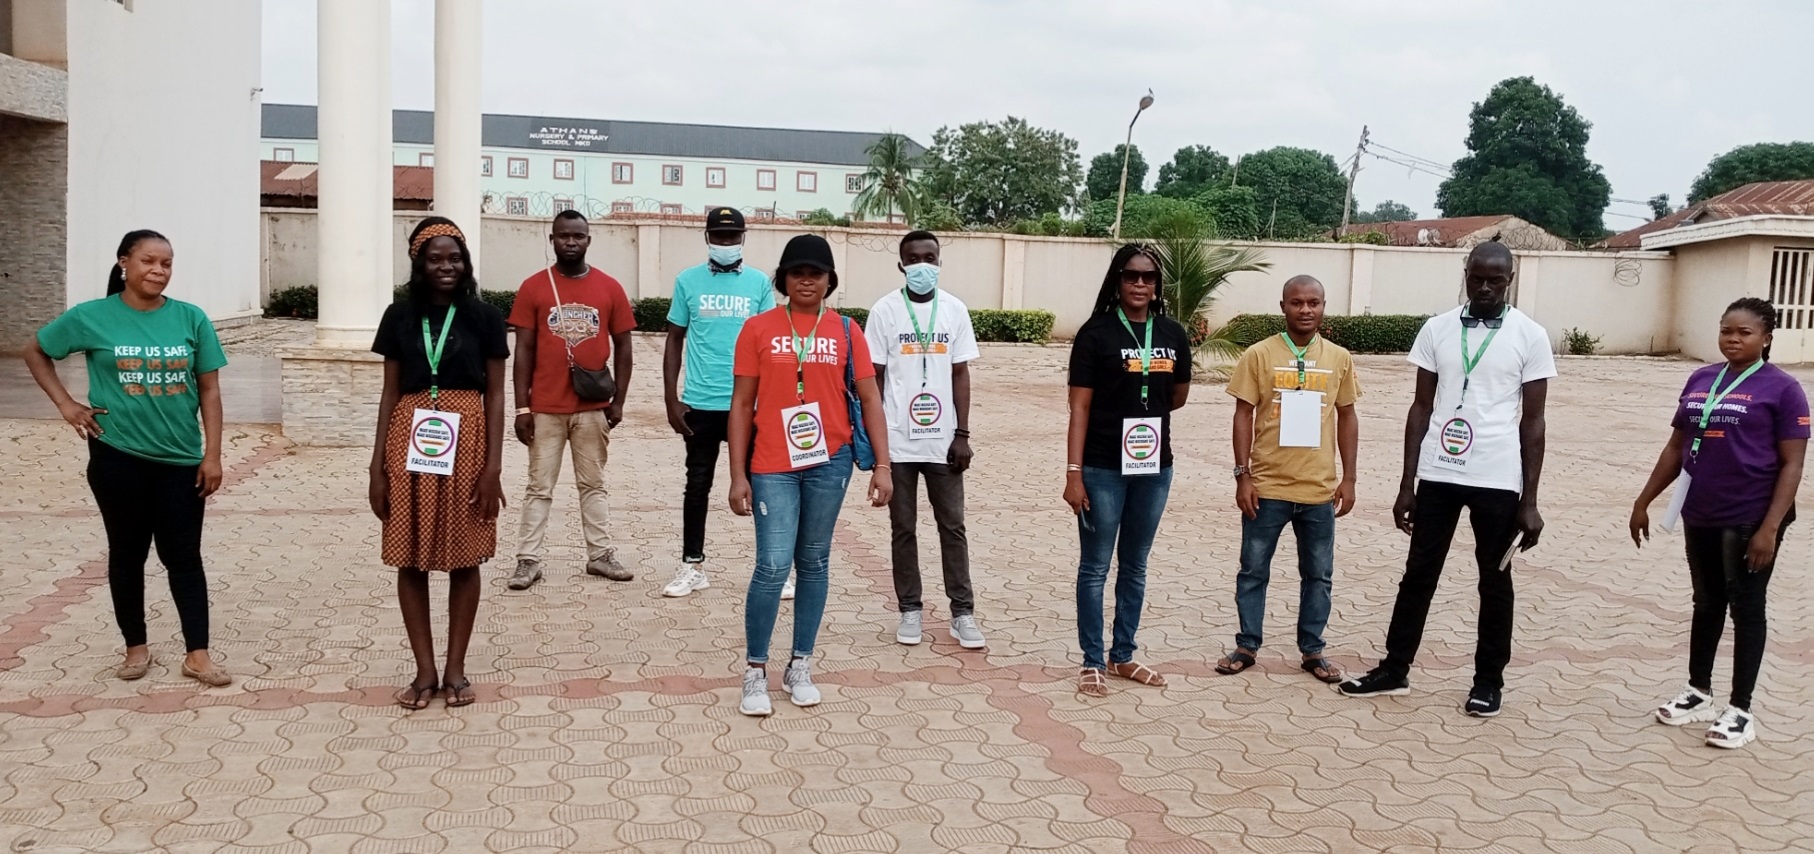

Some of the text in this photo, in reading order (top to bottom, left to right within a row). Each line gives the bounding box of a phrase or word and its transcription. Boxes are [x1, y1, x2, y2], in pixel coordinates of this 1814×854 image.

[700, 294, 751, 312] SECURE
[938, 333, 949, 343] US
[114, 345, 141, 356] KEEP
[145, 346, 160, 357] US
[1121, 348, 1166, 360] PROECT
[166, 359, 188, 370] SAF
[802, 354, 838, 366] UR LIVES
[118, 371, 144, 384] KEEP
[147, 372, 162, 384] US
[1275, 372, 1328, 390] EQITY
[1710, 415, 1720, 423] OUR
[792, 449, 827, 462] COORDINATOR
[1438, 455, 1466, 466] FACILITATOR
[411, 457, 449, 469] FACILITATOR
[1125, 461, 1157, 469] FACILITATOR
